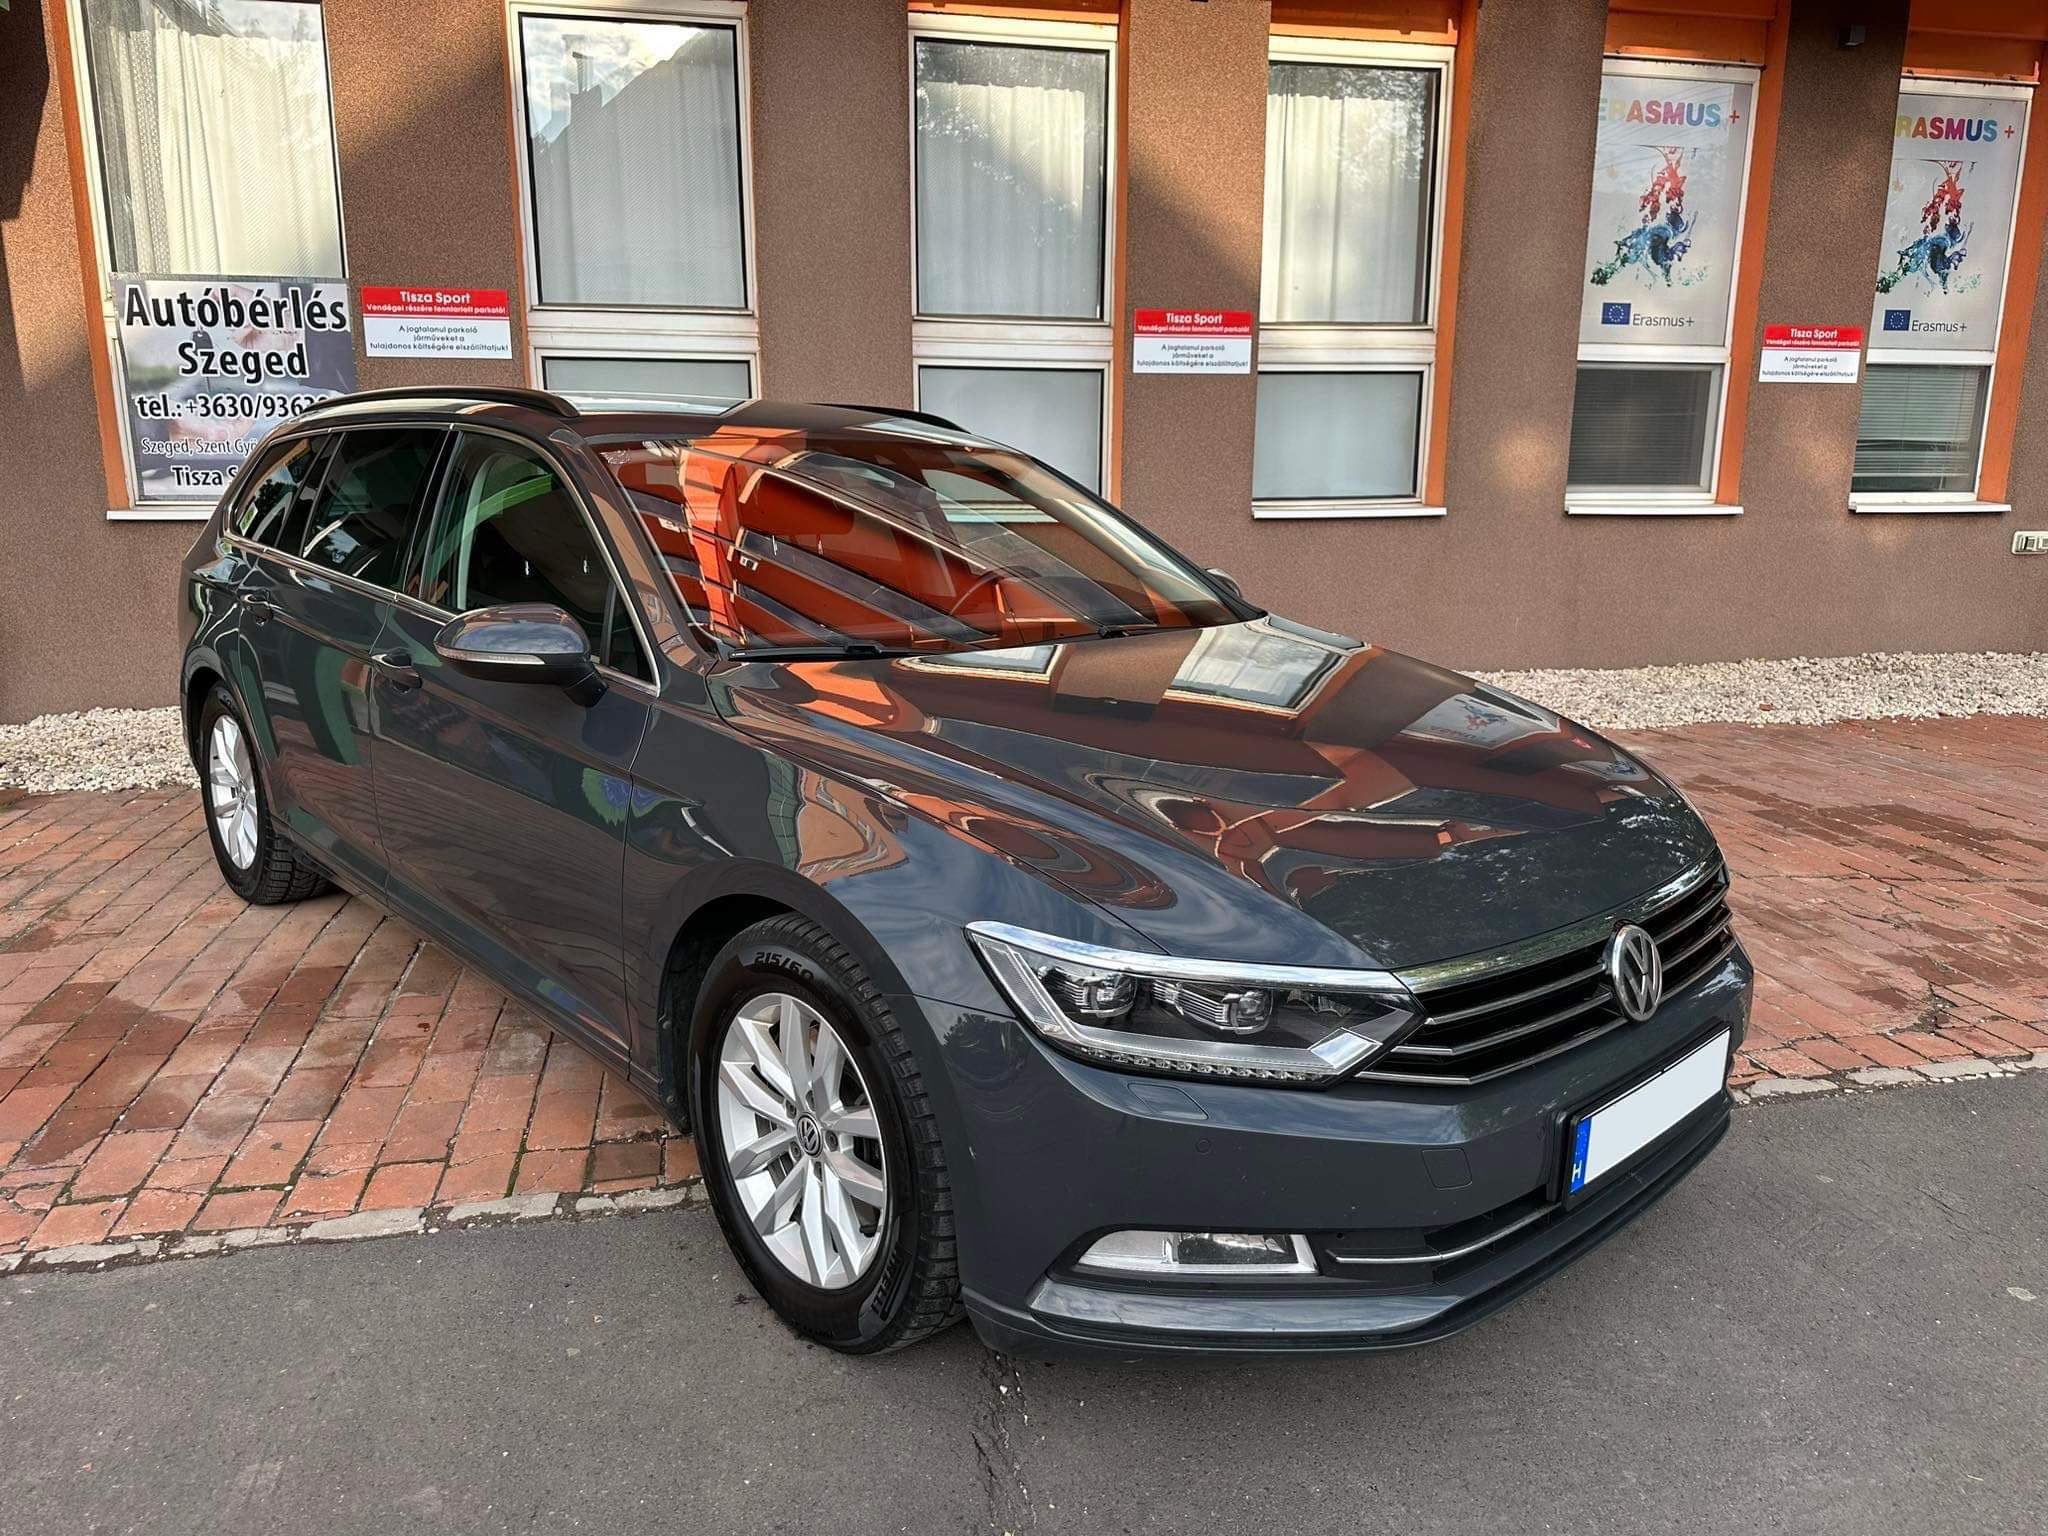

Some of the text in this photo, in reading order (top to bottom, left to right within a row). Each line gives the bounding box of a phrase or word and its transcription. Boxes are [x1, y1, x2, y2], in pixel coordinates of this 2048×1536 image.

[400, 291, 470, 305] Tisza Sport
[126, 287, 347, 329] Autóbérlés
[1166, 312, 1223, 325] Tisza Sport
[1632, 313, 1695, 327] Erasmus+
[1911, 319, 1968, 332] Erasmus+
[1790, 328, 1838, 340] Tisza Sport
[178, 342, 308, 384] Szeged
[142, 439, 193, 456] Szeged,
[196, 439, 231, 453] Szent
[172, 467, 223, 486] Tisza
